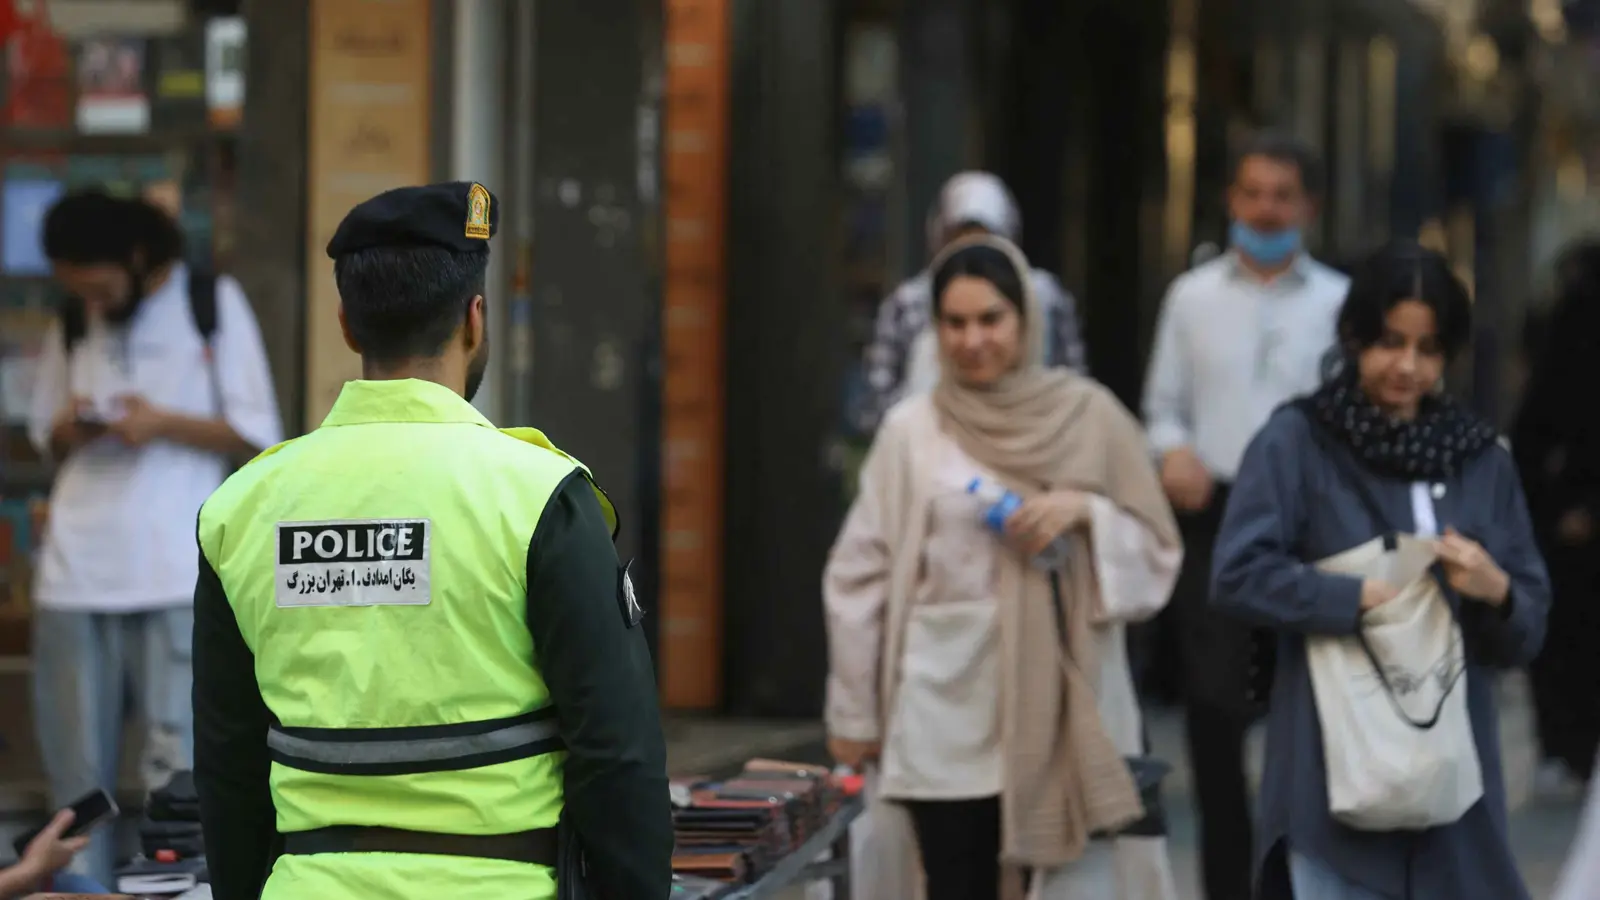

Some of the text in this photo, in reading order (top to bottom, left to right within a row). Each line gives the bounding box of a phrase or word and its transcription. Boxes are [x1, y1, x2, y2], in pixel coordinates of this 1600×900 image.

[293, 528, 413, 560] POLICE
[287, 570, 316, 594] بزرگ
[317, 569, 345, 593] تهران
[393, 566, 416, 591] یگان
